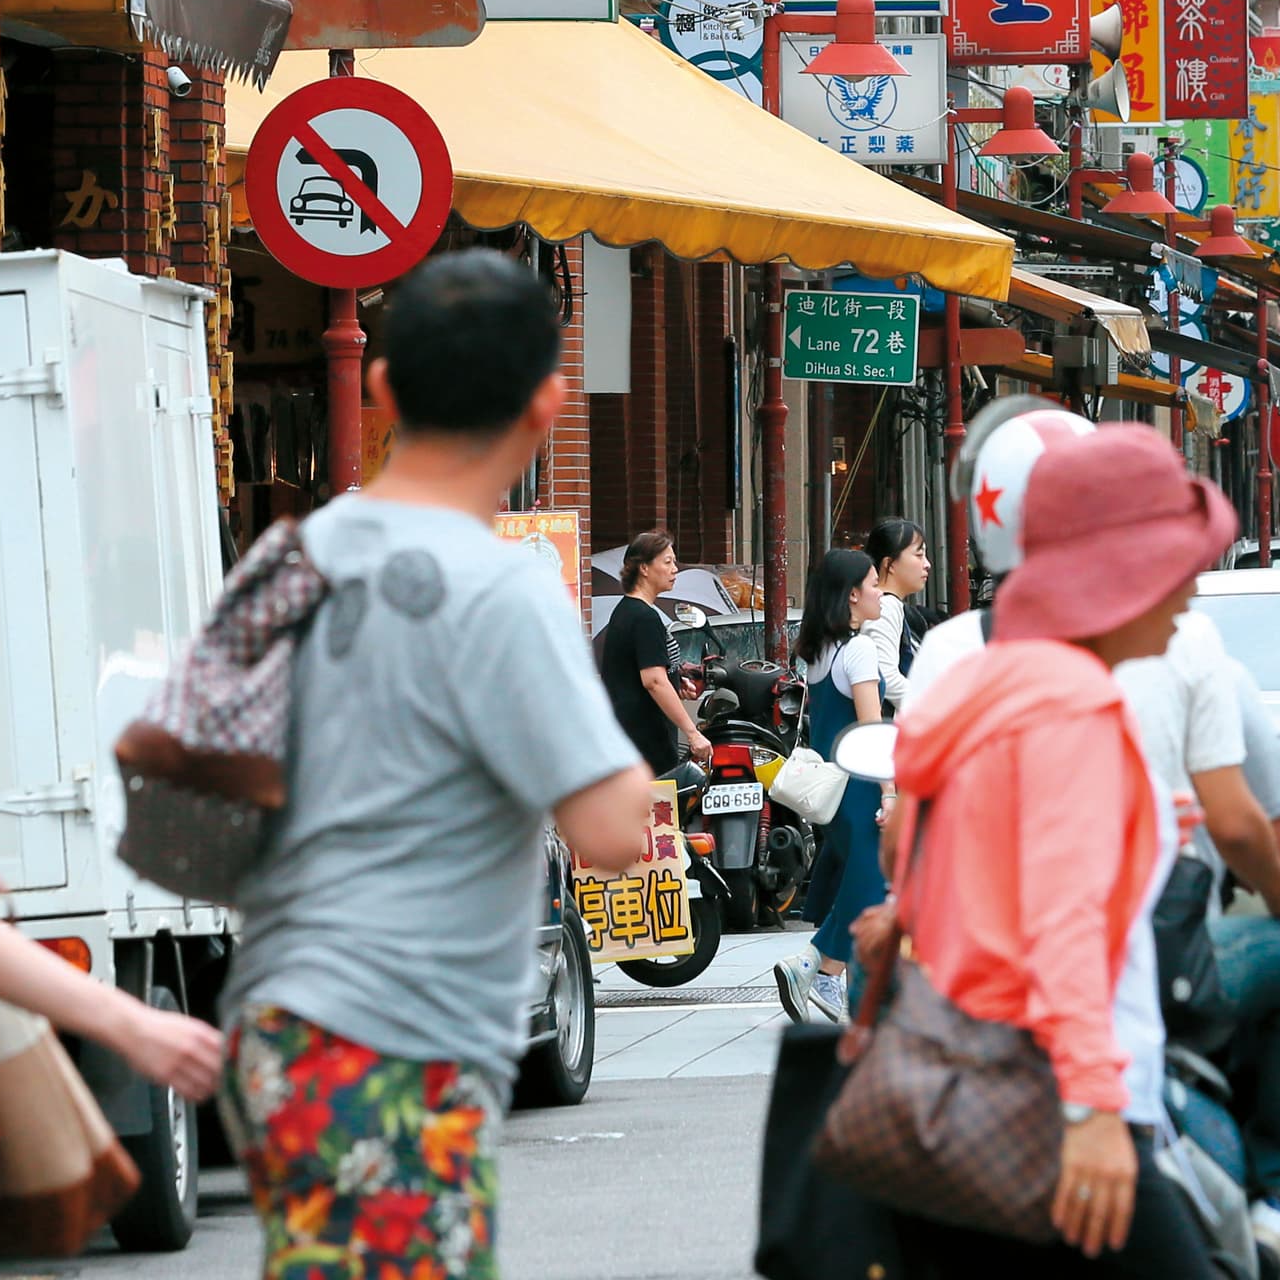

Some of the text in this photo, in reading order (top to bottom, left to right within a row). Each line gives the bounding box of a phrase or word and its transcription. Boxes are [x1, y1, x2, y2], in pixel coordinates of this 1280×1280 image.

[818, 135, 915, 154] 正製薬
[797, 296, 907, 320] 迪化街一段
[808, 328, 907, 354] Lane 72 巷
[805, 361, 895, 378] DiHua St. Sec.1
[652, 799, 678, 860] 貴賓
[574, 869, 687, 952] 停車位
